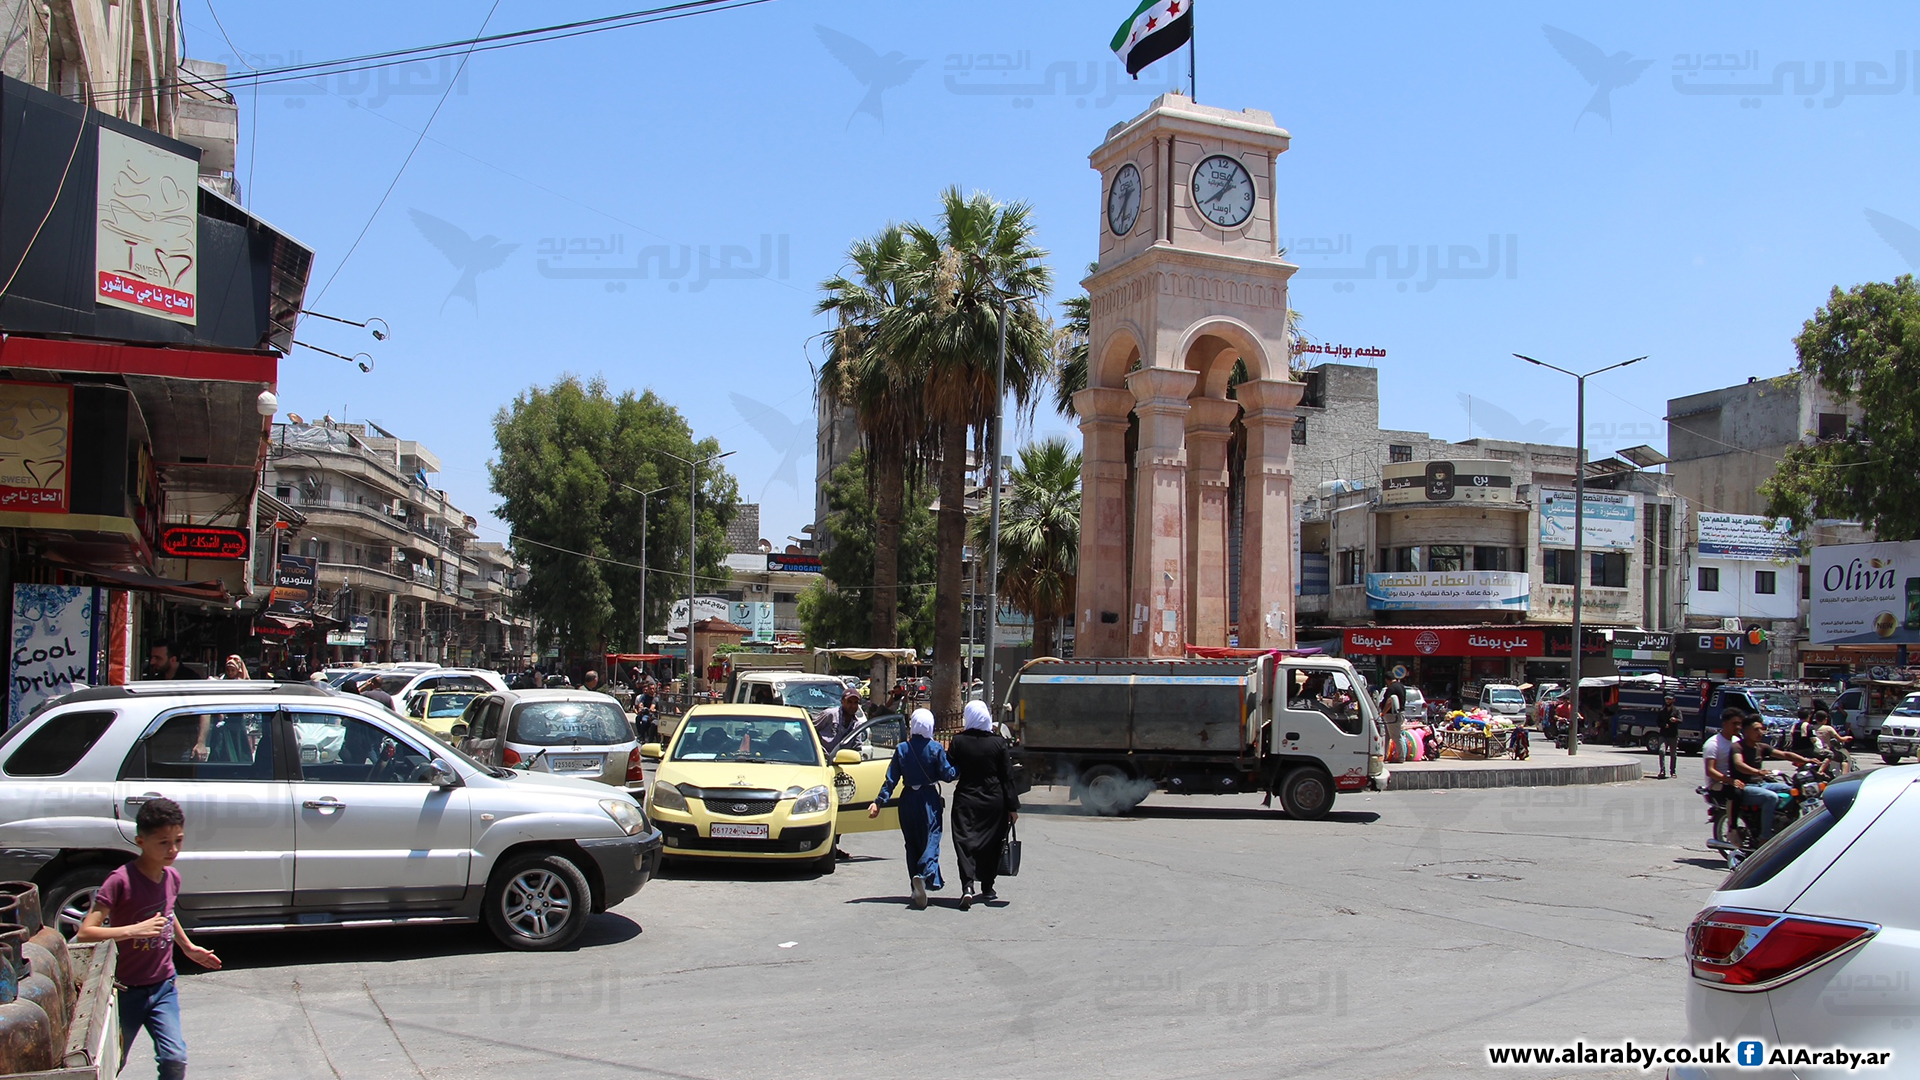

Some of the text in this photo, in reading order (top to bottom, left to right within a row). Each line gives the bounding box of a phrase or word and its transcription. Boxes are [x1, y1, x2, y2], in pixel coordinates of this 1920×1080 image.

[1218, 160, 1229, 168] 12
[1211, 171, 1233, 182] OSA
[1194, 184, 1200, 192] 9
[1244, 193, 1250, 201] 3
[1219, 216, 1225, 225] 6
[134, 263, 163, 278] SWEET
[101, 277, 193, 309] الحاج ناجي عاشور
[1325, 343, 1352, 358] بوابة
[1355, 346, 1386, 358] مطعم
[1, 476, 32, 484] SWEET
[1389, 476, 1488, 490] بن شريط
[2, 490, 61, 505] الحاج ناجي
[281, 577, 312, 585] ستوديو
[1431, 575, 1475, 587] العطاء
[1823, 558, 1895, 592] Oliva
[1378, 575, 1427, 590] التخصصي
[710, 602, 726, 611] فروج
[1876, 621, 1894, 629] NEW
[1352, 634, 1393, 650] علي بوظة
[1468, 635, 1528, 651] علي بوظة
[1698, 635, 1741, 650] GSM
[13, 637, 76, 666] Cool
[14, 665, 86, 693] Drink
[712, 826, 737, 835] 061724
